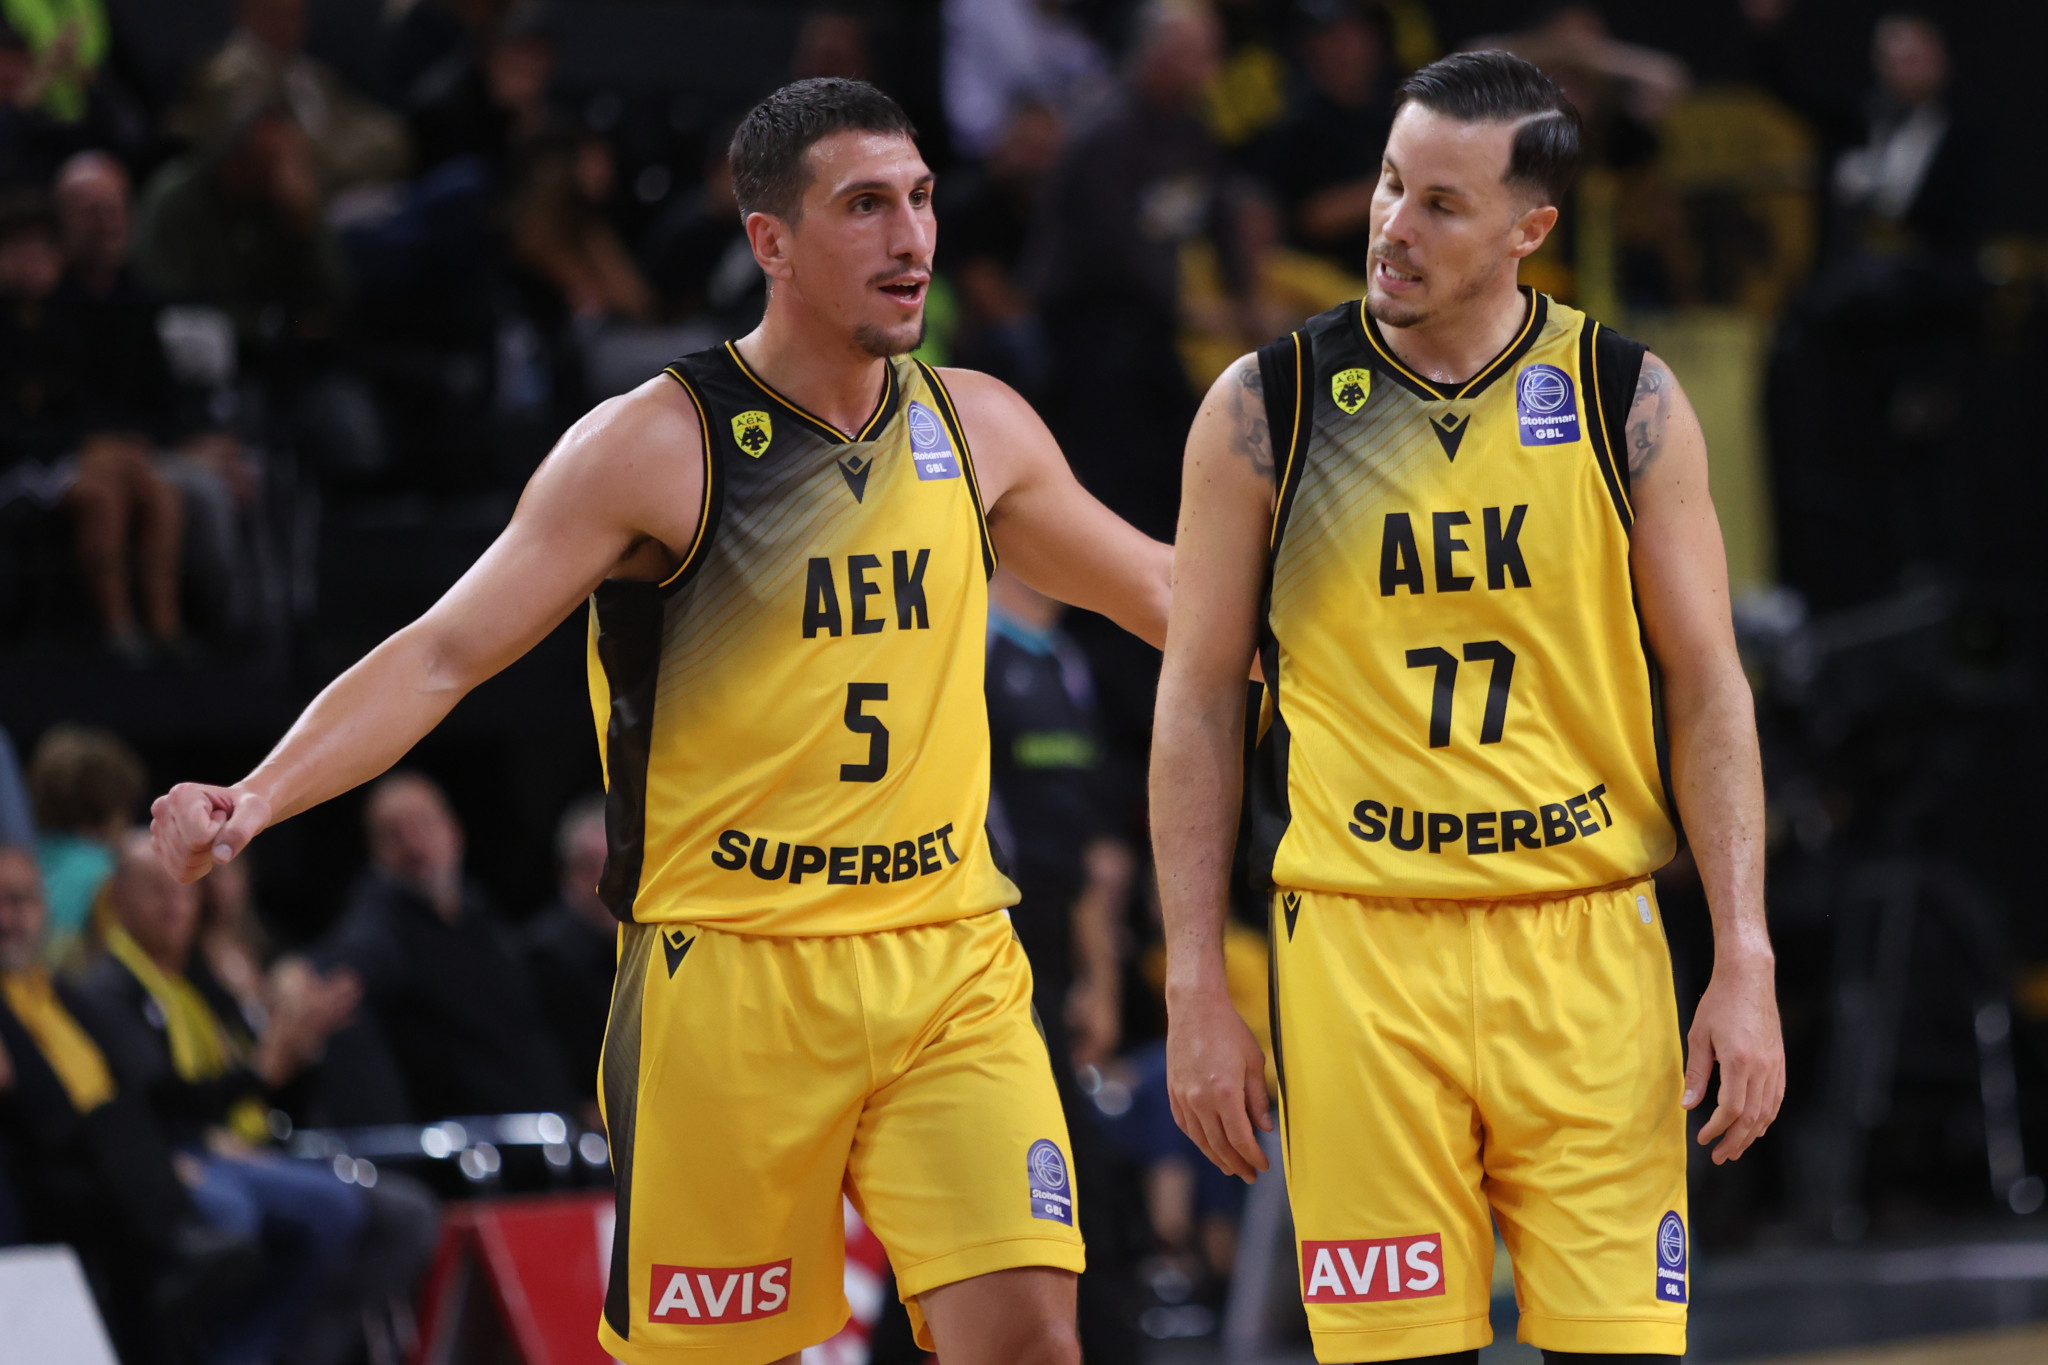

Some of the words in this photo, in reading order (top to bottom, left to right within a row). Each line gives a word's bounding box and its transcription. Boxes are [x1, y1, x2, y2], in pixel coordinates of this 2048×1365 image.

[1520, 414, 1576, 425] Stoiximan
[1536, 428, 1564, 439] GBL
[925, 462, 947, 474] GBL
[1379, 504, 1532, 597] AEK
[802, 548, 931, 639] AEK
[1405, 640, 1516, 749] 77
[839, 682, 889, 783] 5
[1348, 783, 1613, 855] SUPERBET
[711, 822, 960, 885] SUPERBET
[1045, 1203, 1065, 1218] GBL
[653, 1266, 788, 1318] AVIS
[1307, 1240, 1440, 1296] AVIS
[1665, 1283, 1680, 1296] GBL
